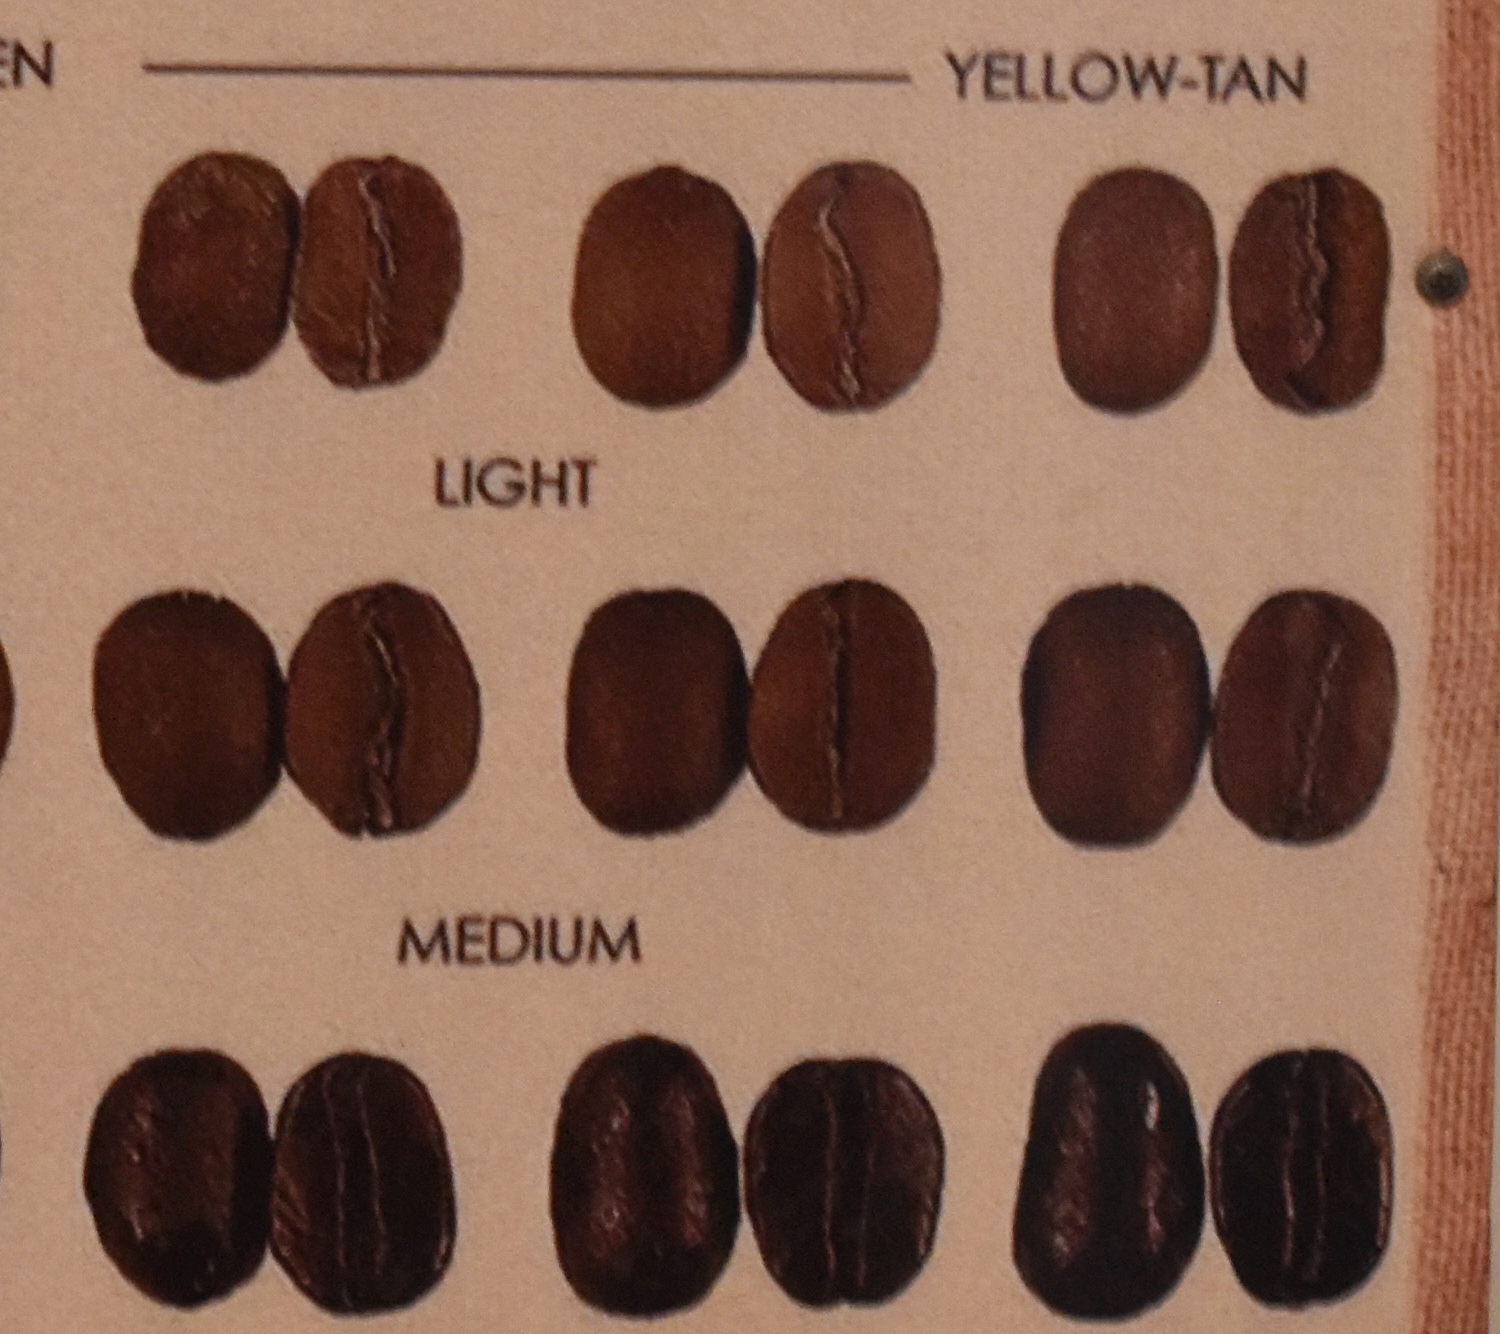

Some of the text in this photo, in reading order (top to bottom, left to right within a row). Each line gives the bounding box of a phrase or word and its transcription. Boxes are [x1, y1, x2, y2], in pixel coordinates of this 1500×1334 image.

[945, 51, 1308, 103] YELLOW-TAN
[434, 455, 594, 508] LIGHT
[397, 914, 642, 966] MEDIUM
